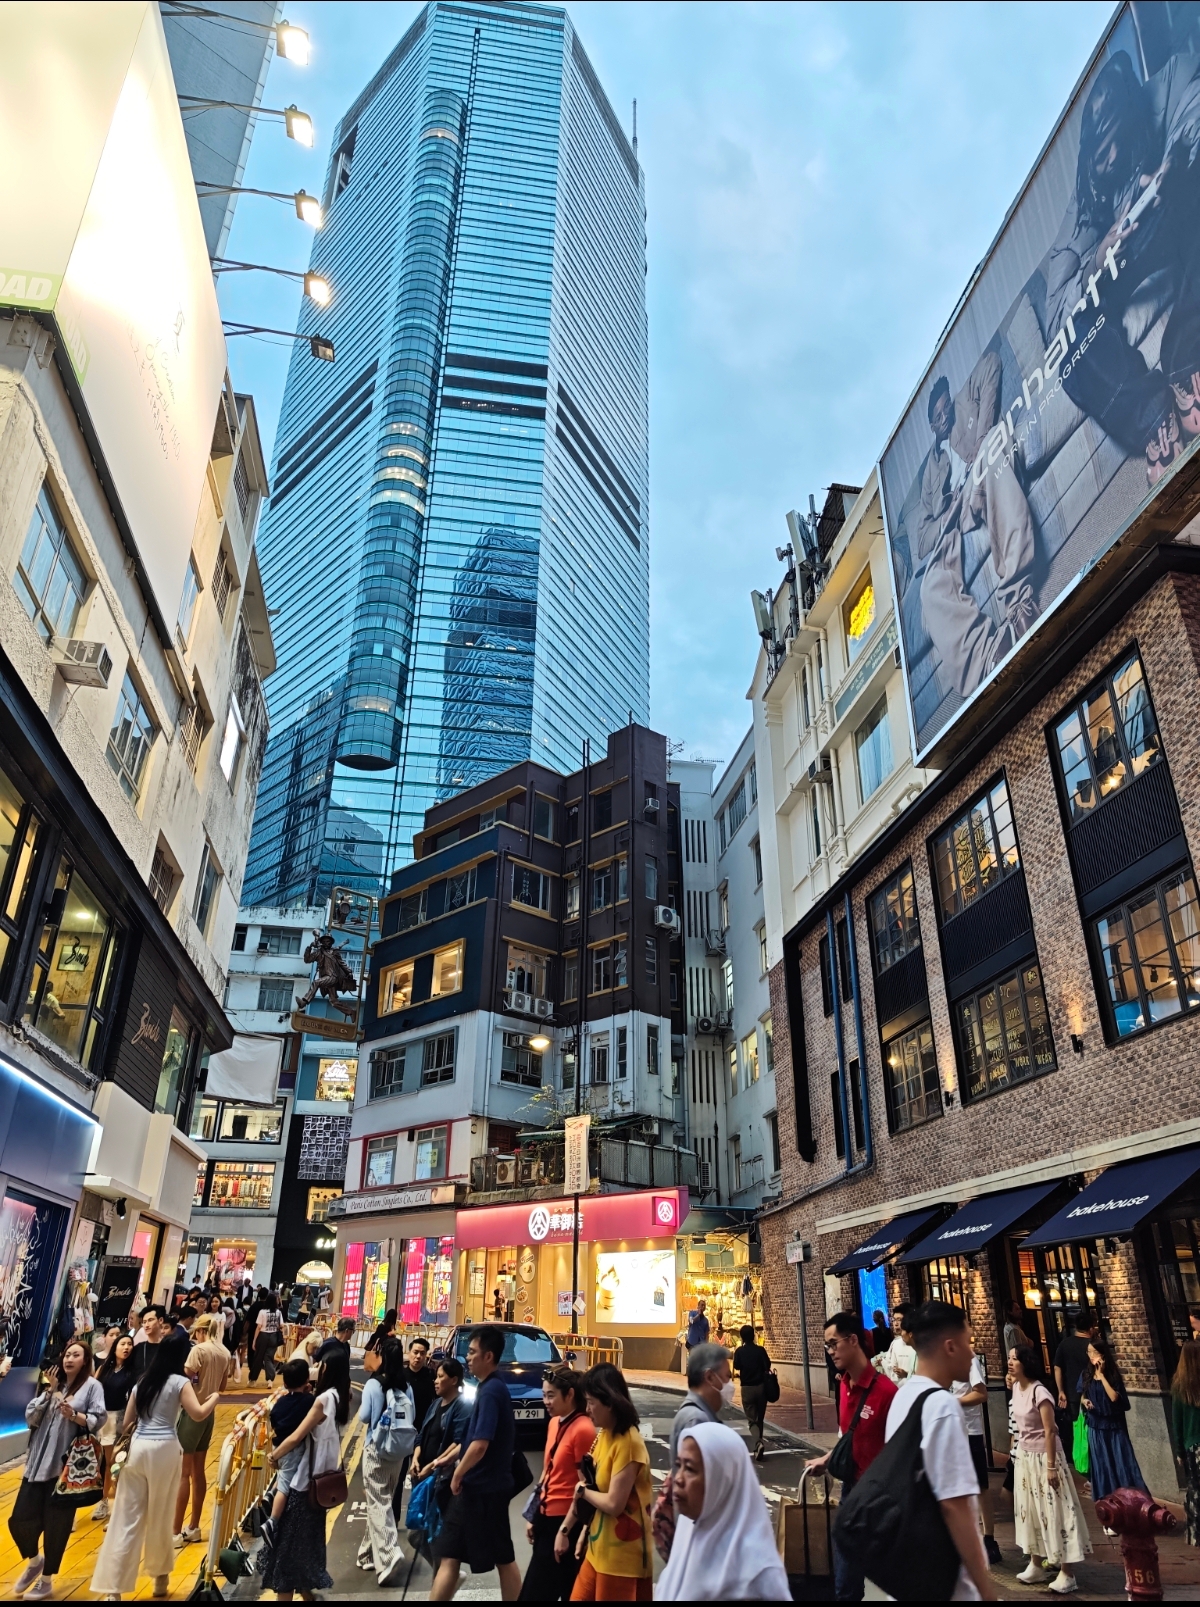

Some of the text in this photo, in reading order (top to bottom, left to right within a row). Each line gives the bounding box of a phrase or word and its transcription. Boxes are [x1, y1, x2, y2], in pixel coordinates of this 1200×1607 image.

[0, 272, 53, 300] AD
[972, 239, 1121, 486] carhartt
[994, 313, 1106, 479] WORK IN PROGRESS
[1066, 1194, 1150, 1218] bakehouse
[937, 1223, 993, 1240] bakehouse
[853, 1241, 892, 1255] bakehouse
[525, 1410, 539, 1418] 291
